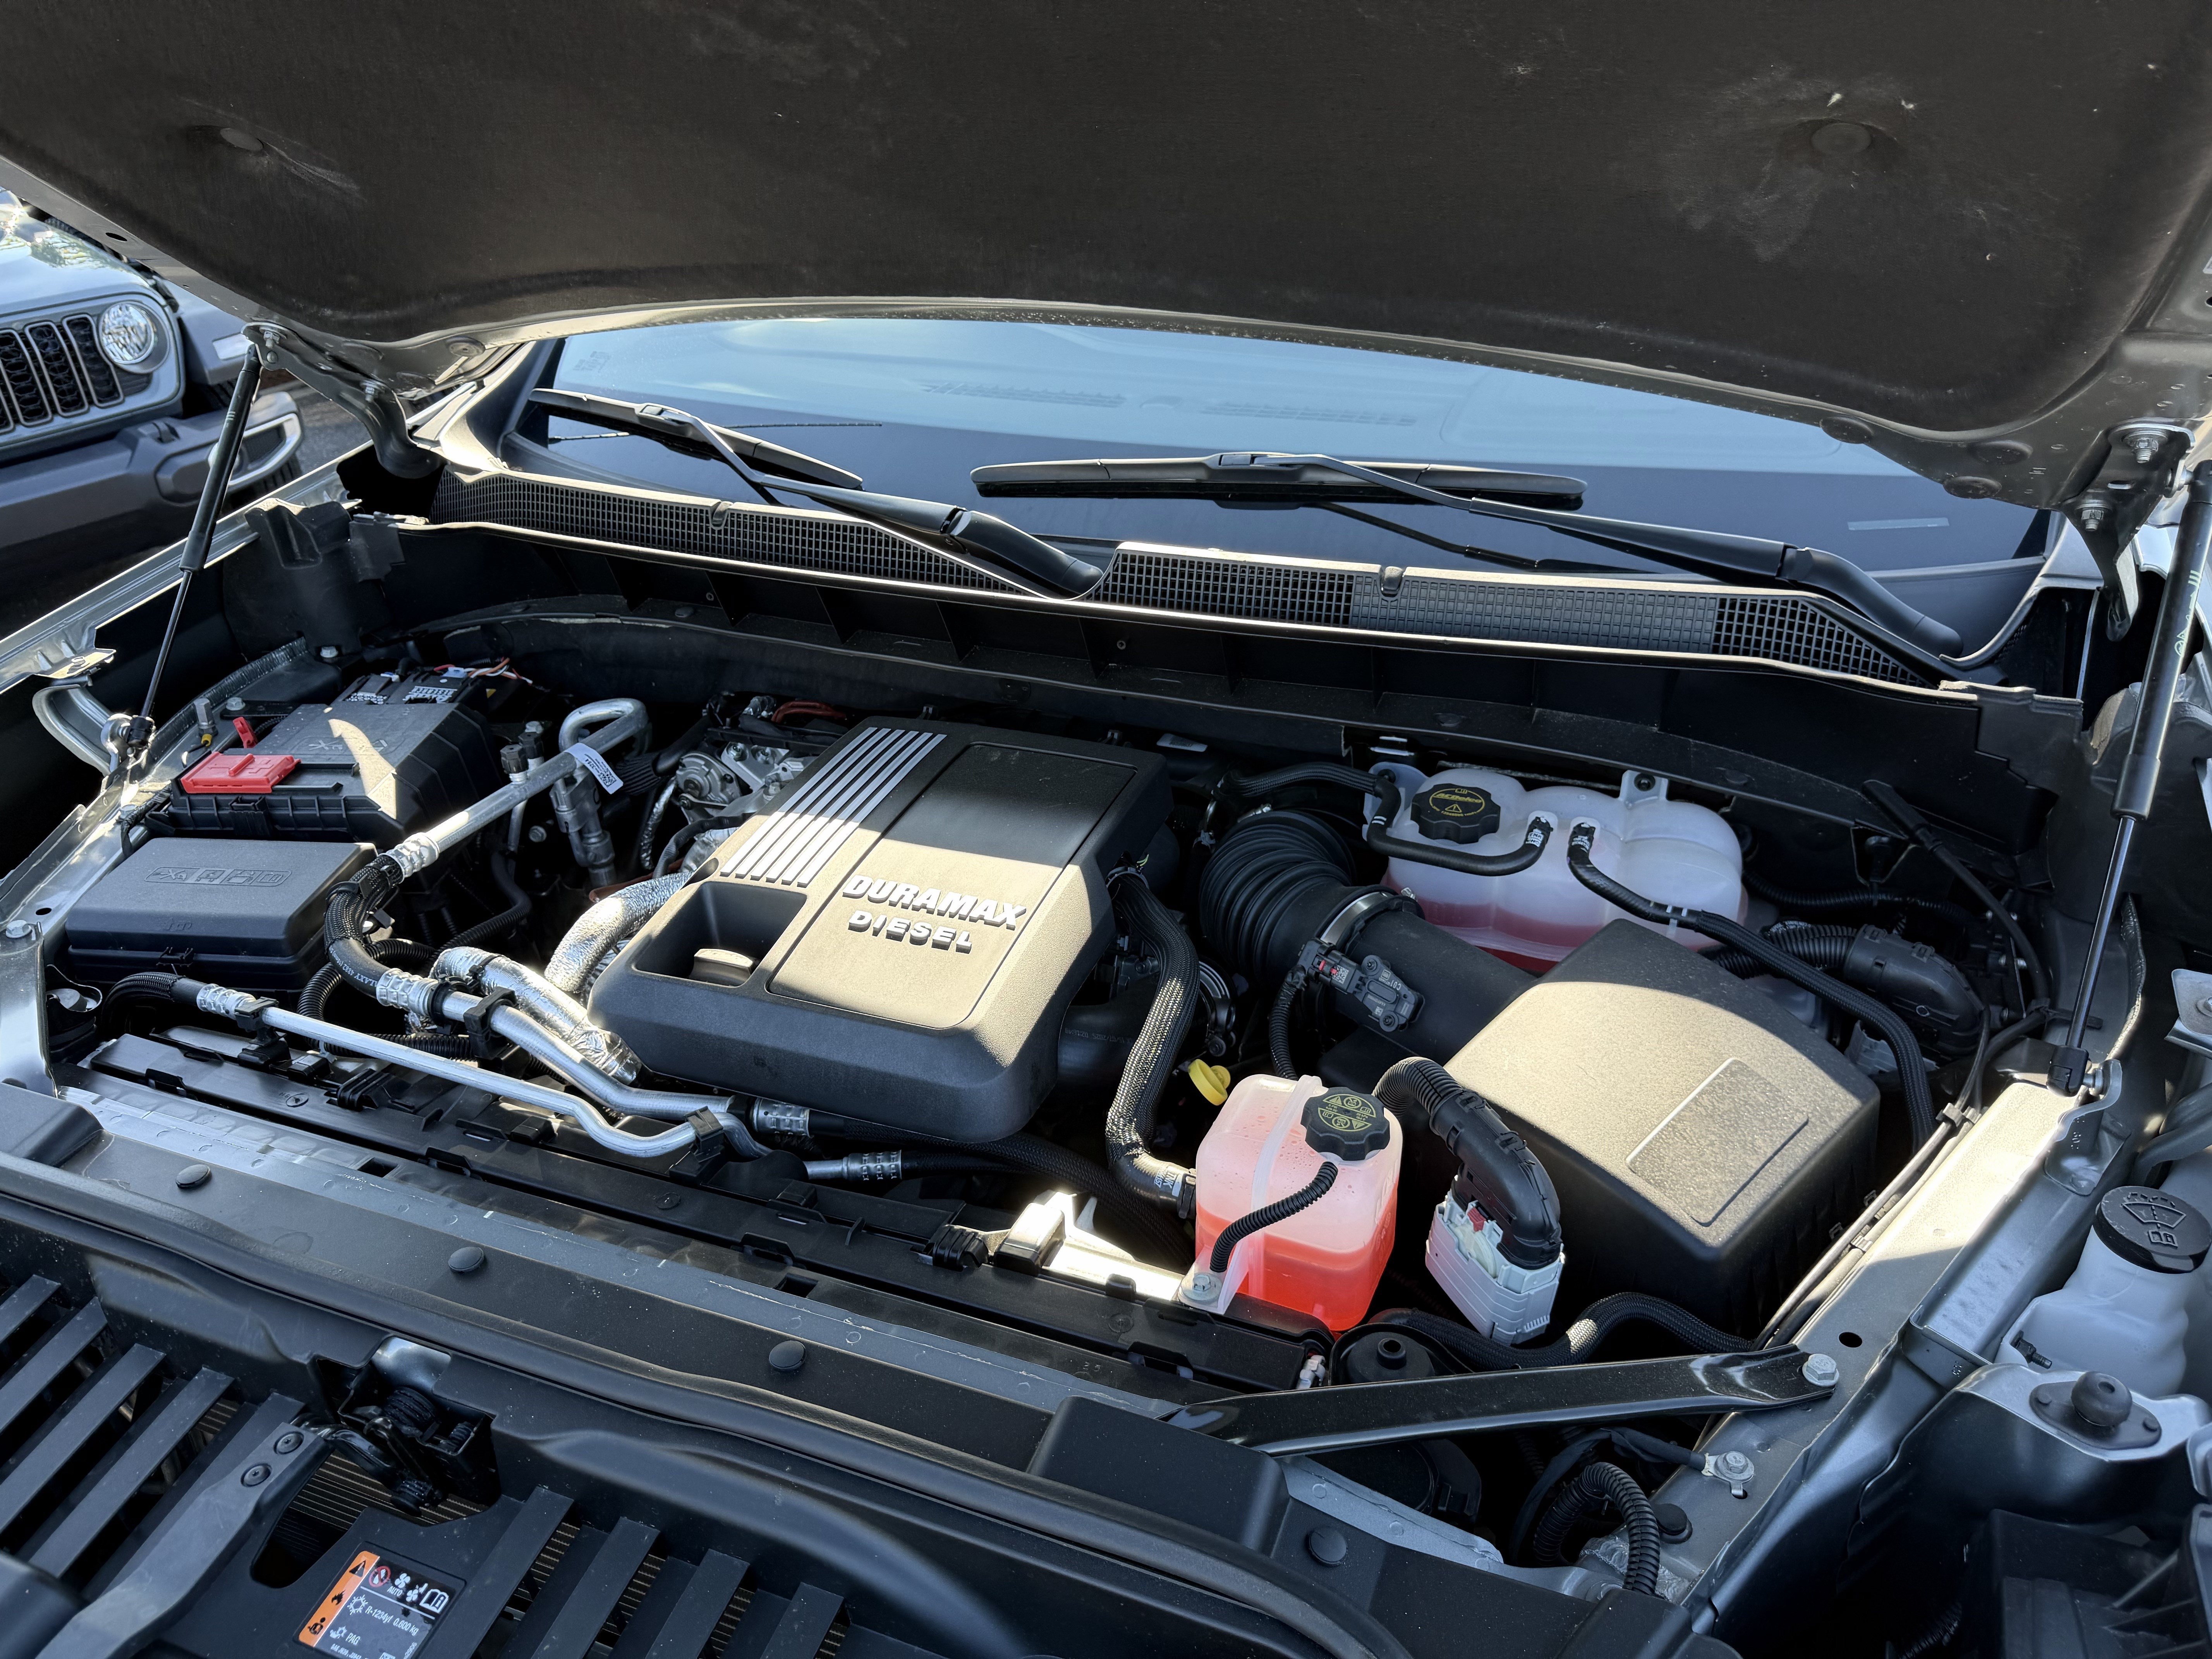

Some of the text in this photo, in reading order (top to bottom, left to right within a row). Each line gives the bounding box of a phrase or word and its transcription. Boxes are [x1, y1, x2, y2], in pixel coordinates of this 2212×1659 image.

[842, 875, 1027, 930] DURAMAX
[848, 910, 972, 953] DIESEL
[387, 1586, 403, 1596] AUTO
[365, 1606, 393, 1623] R-1234yf
[409, 1625, 419, 1636] kg
[345, 1632, 361, 1645] PAG
